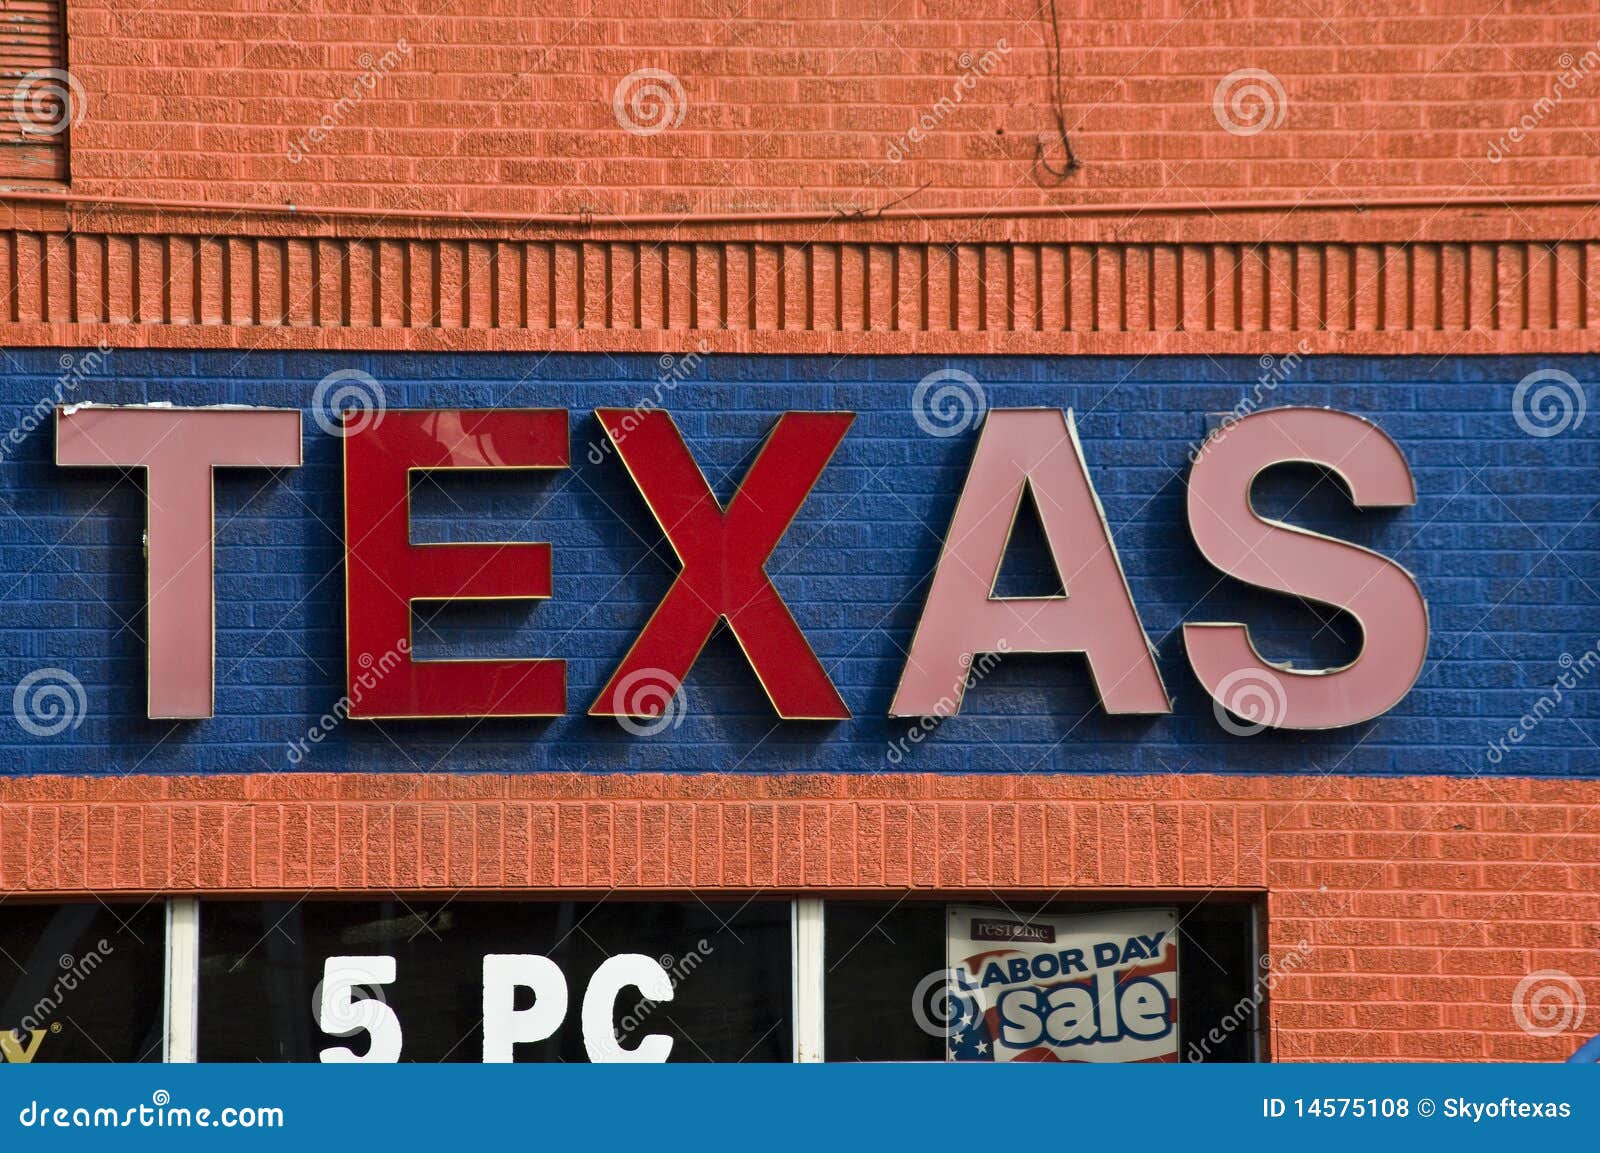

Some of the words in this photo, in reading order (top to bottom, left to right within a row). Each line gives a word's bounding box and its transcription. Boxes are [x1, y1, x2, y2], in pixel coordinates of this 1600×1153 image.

[55, 403, 1429, 731] TEXAS
[319, 956, 403, 1063] 5
[482, 953, 674, 1063] PC
[955, 948, 1089, 993] LABOR
[1093, 931, 1166, 969] DAY
[999, 969, 1170, 1046] sale
